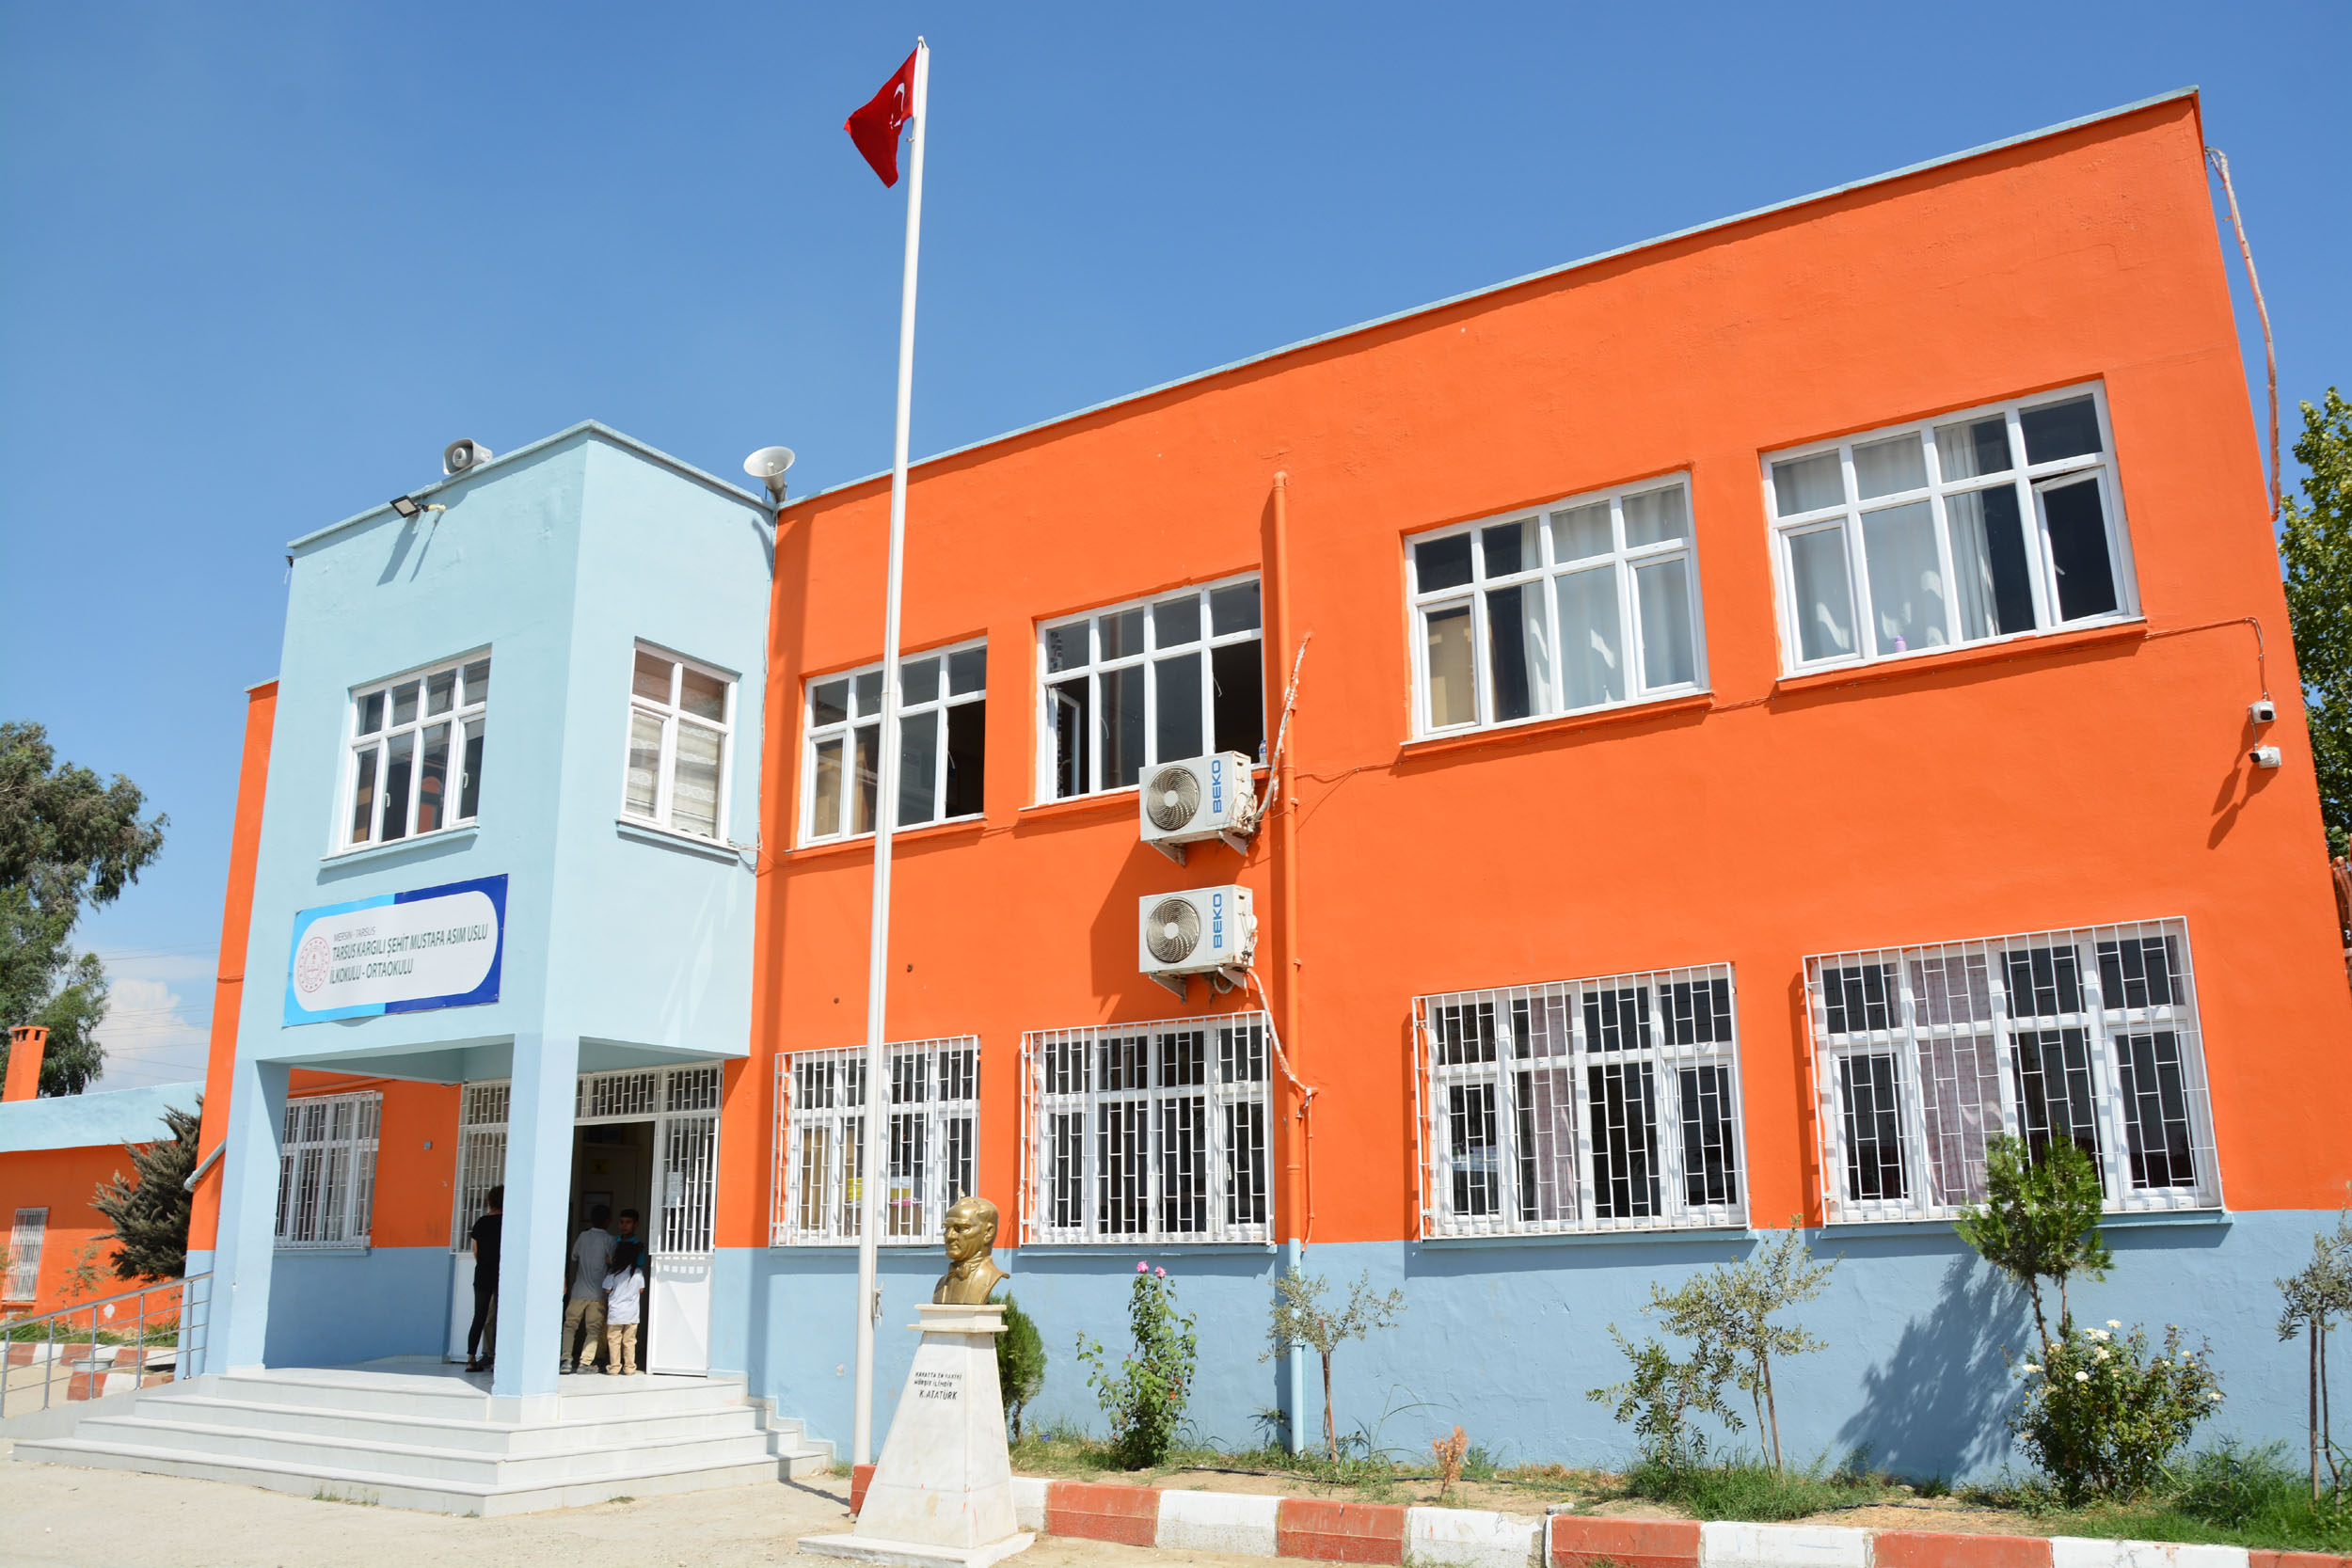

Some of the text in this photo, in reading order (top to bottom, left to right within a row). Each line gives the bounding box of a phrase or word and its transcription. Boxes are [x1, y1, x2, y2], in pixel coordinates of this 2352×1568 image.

[1212, 760, 1222, 814] BEKO
[333, 924, 488, 961] TARSUS KARGILI ŞEHİT MUSTAFA ASIM USLU
[1213, 894, 1222, 949] BEKO
[329, 965, 361, 984] İLKOKULU
[366, 958, 414, 978] ORTAOKULU
